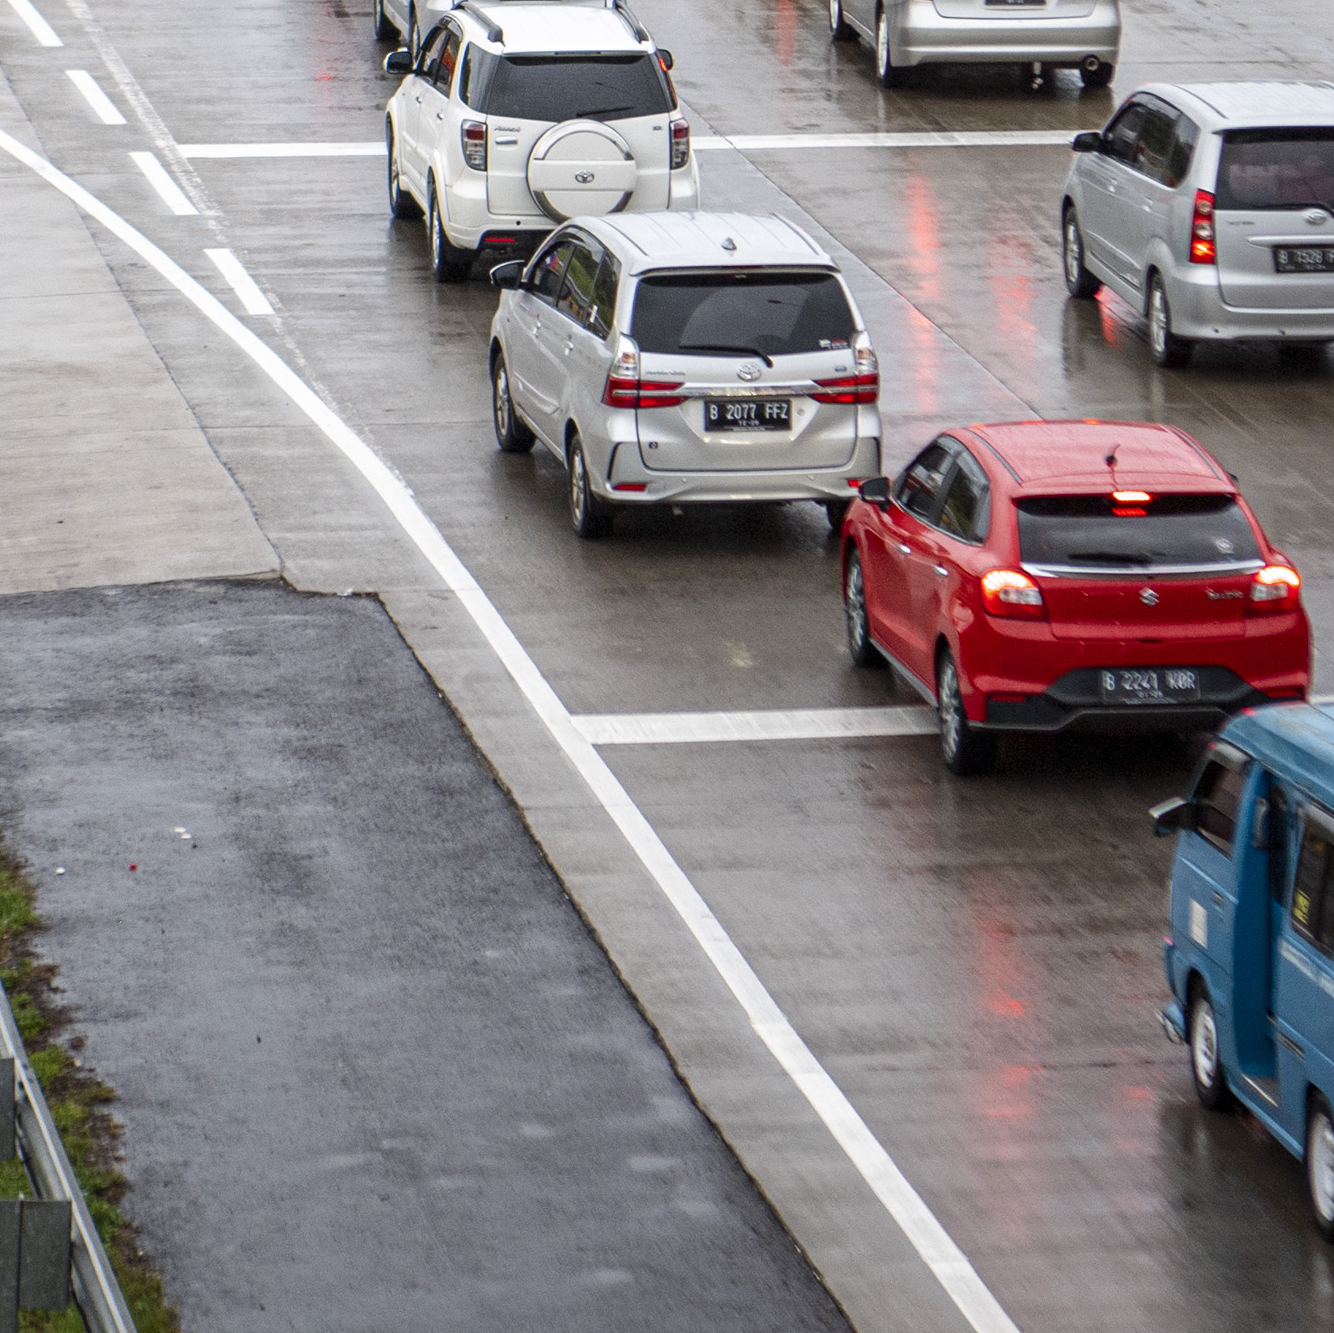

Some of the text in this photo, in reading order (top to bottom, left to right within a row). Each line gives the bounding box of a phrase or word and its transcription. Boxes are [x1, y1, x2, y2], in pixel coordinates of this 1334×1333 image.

[709, 402, 789, 420] B 2077 FFZ
[1103, 669, 1116, 690] B
[1120, 669, 1159, 690] 2241
